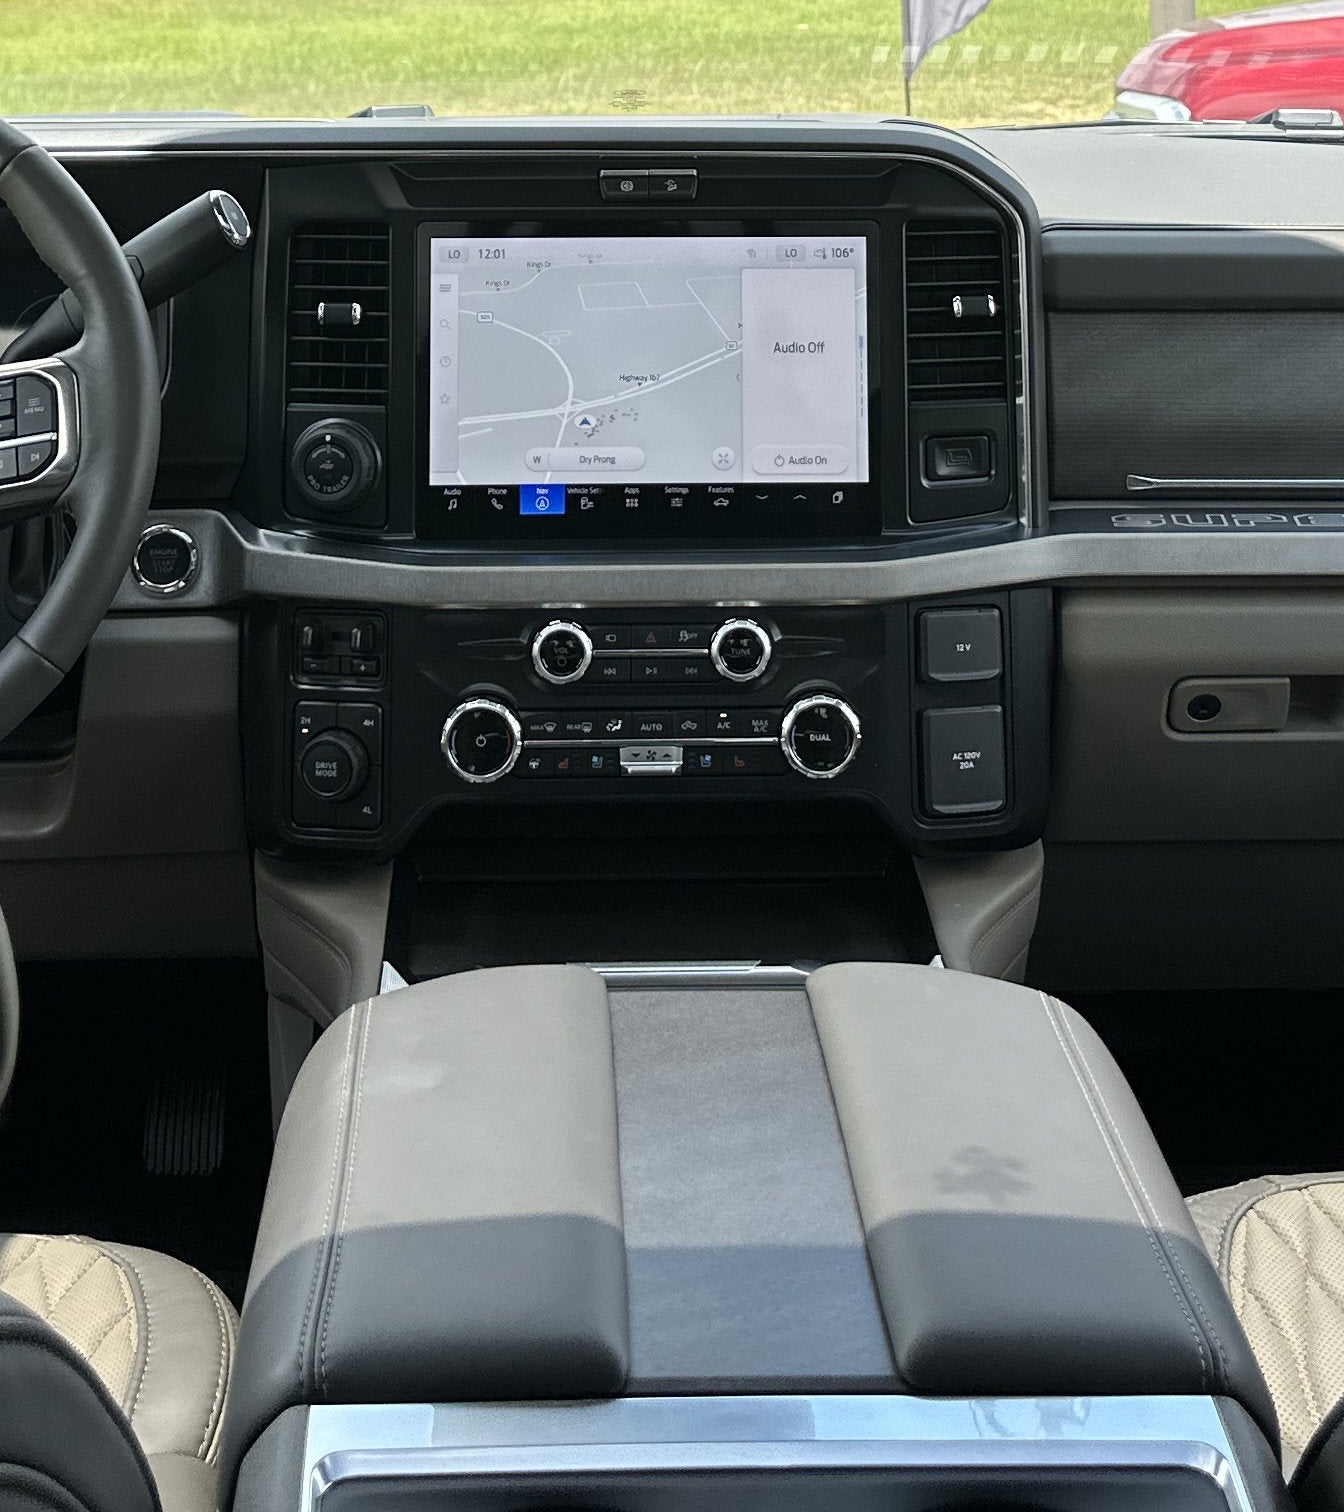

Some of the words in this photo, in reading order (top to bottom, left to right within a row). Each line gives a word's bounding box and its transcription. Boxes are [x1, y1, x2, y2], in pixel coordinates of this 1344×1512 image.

[478, 248, 506, 259] 12:01
[785, 249, 798, 258] LO
[773, 342, 805, 353] Audio
[808, 342, 825, 353] Off
[619, 374, 647, 383] Highway
[580, 456, 592, 465] Dry
[594, 456, 616, 465] Prong
[788, 455, 813, 464] Audio
[815, 456, 827, 464] On
